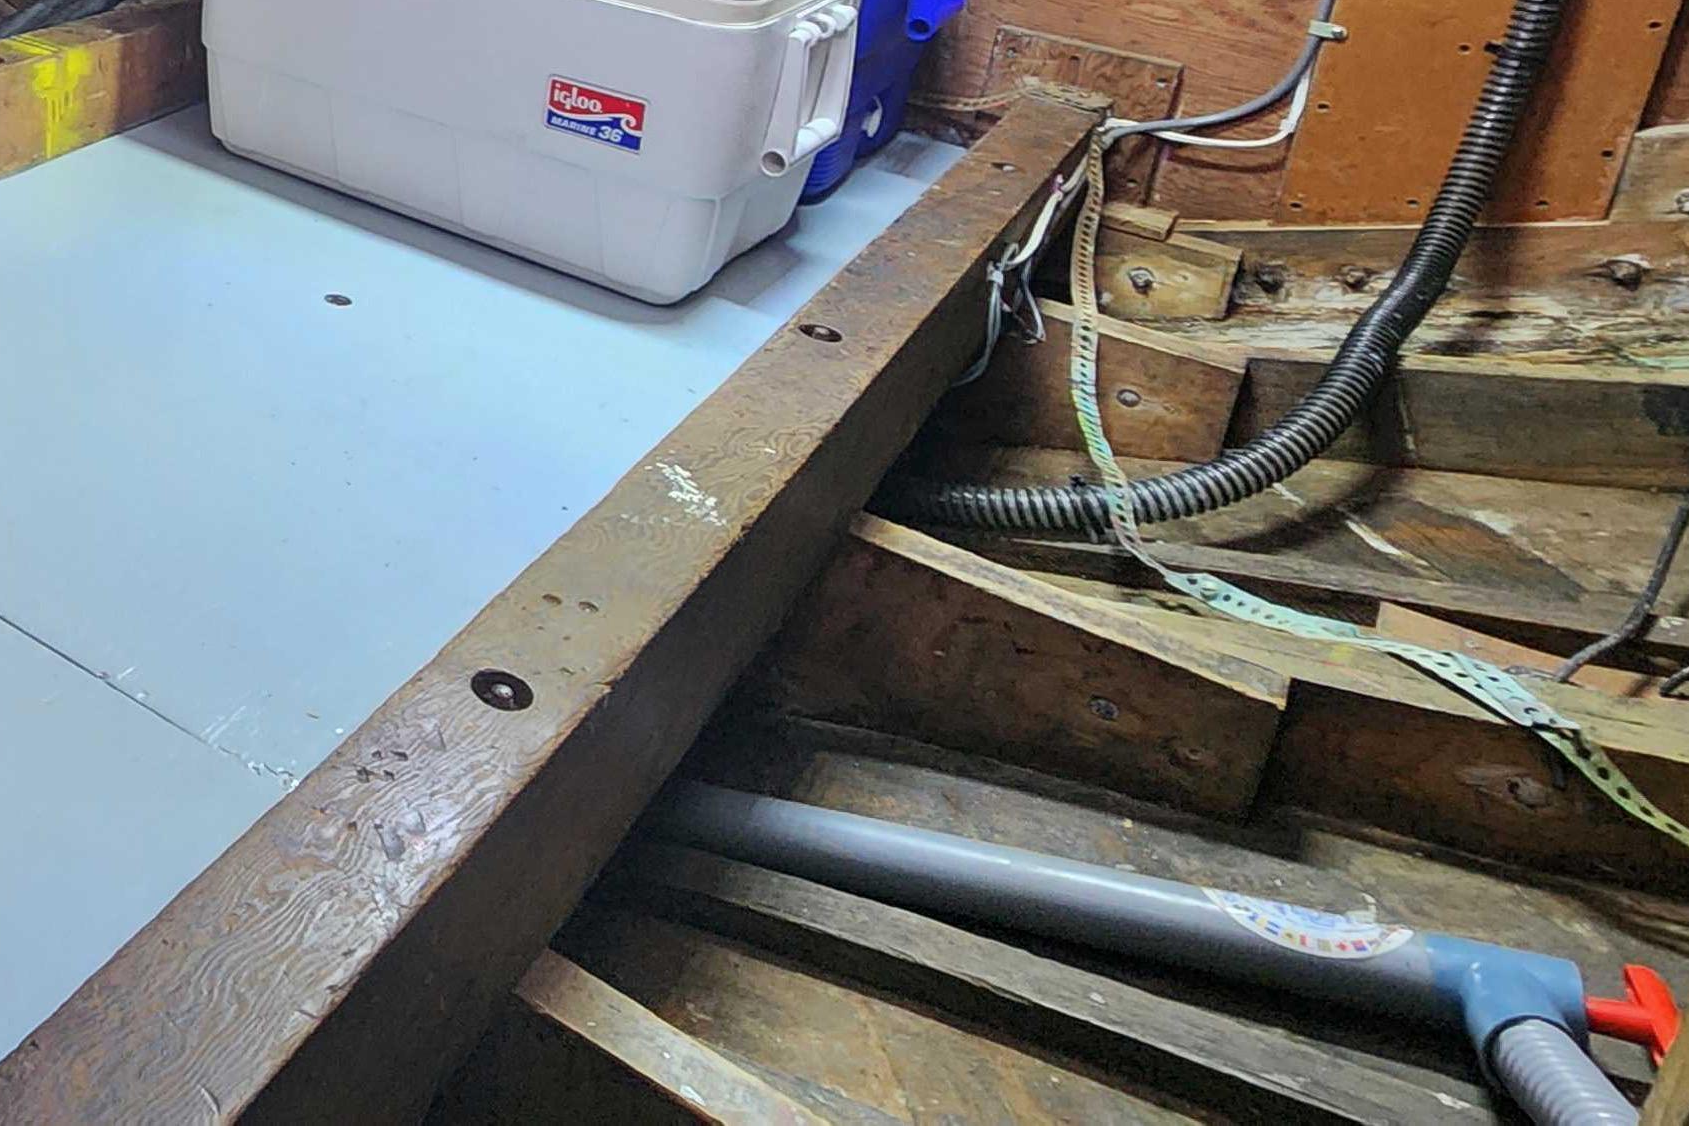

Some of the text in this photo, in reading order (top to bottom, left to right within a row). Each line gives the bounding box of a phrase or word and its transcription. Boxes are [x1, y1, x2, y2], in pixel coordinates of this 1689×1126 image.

[553, 82, 601, 113] igloo
[550, 116, 625, 143] MARINE 36
